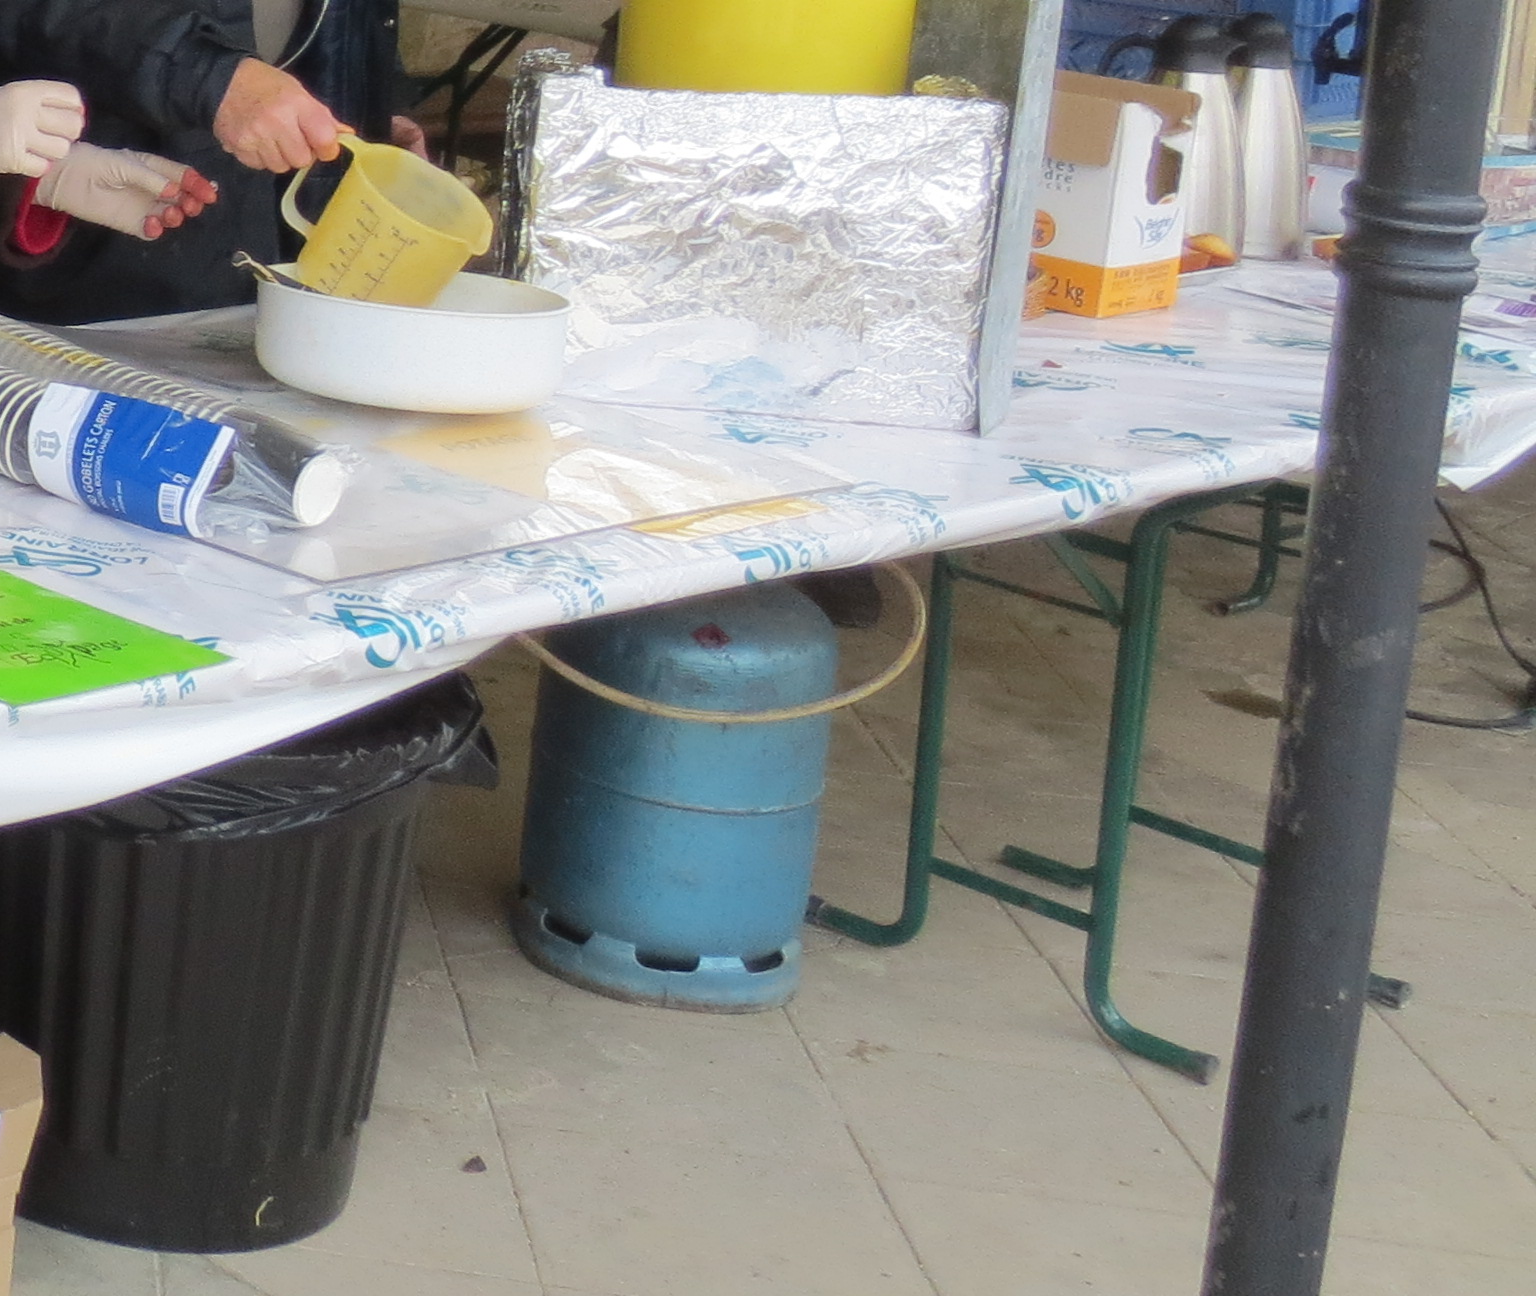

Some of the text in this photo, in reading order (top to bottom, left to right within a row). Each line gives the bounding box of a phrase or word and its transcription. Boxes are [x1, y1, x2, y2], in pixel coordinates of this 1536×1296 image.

[1048, 276, 1059, 297] 2
[1064, 279, 1084, 307] kg
[81, 399, 117, 493] GOBELETS CARTON
